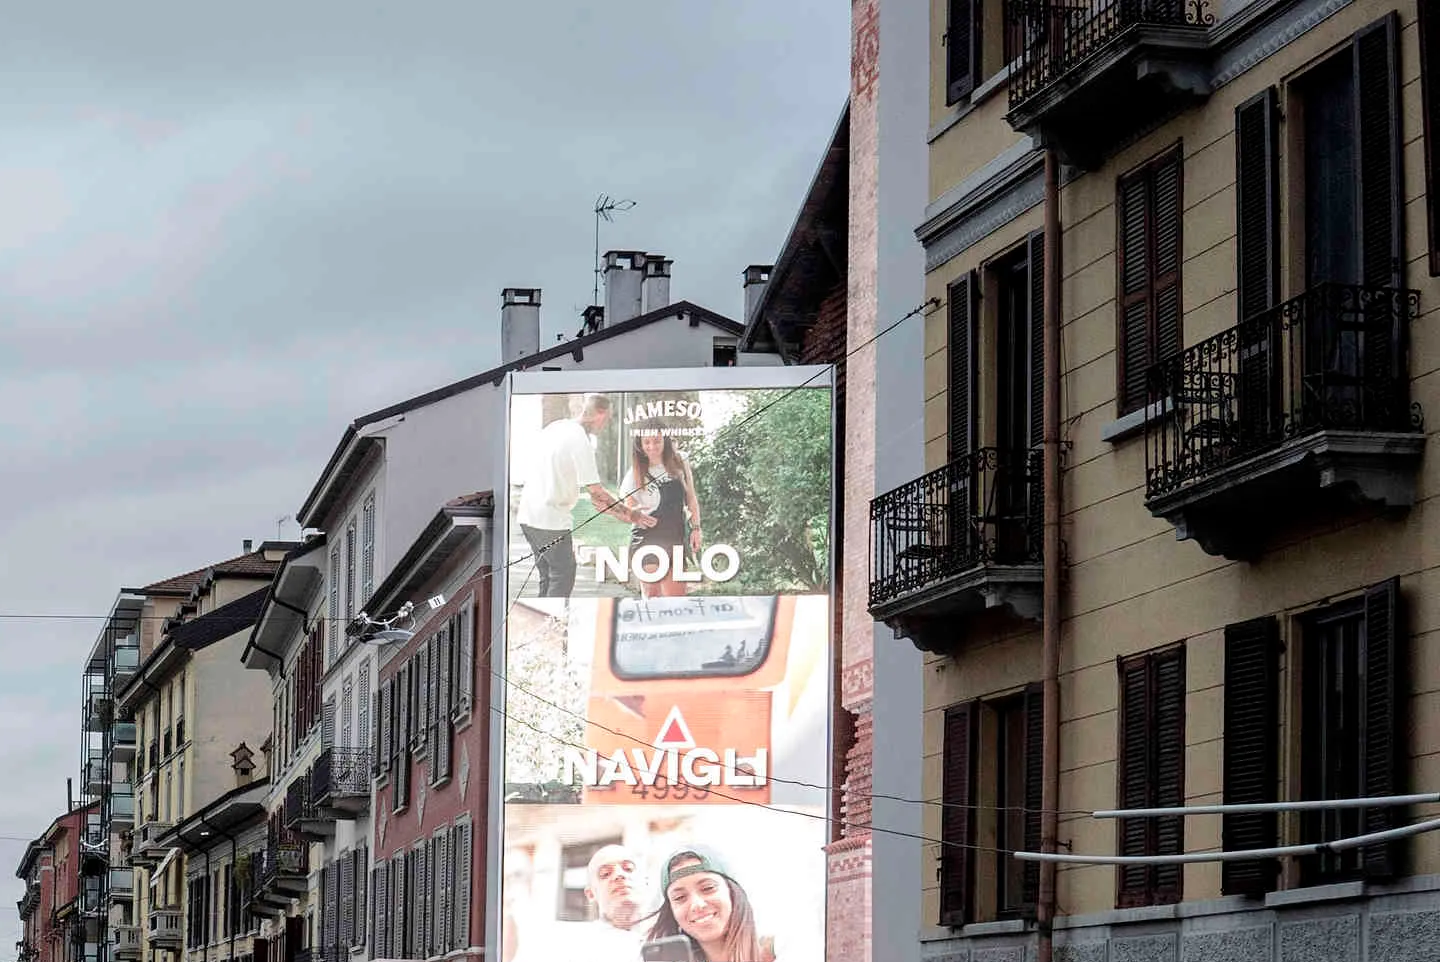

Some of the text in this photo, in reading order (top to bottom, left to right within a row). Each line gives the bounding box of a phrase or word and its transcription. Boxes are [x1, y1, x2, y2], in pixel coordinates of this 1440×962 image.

[623, 399, 709, 425] JAMESO
[595, 543, 740, 583] NOLO
[563, 748, 769, 787] NAVIGLI
